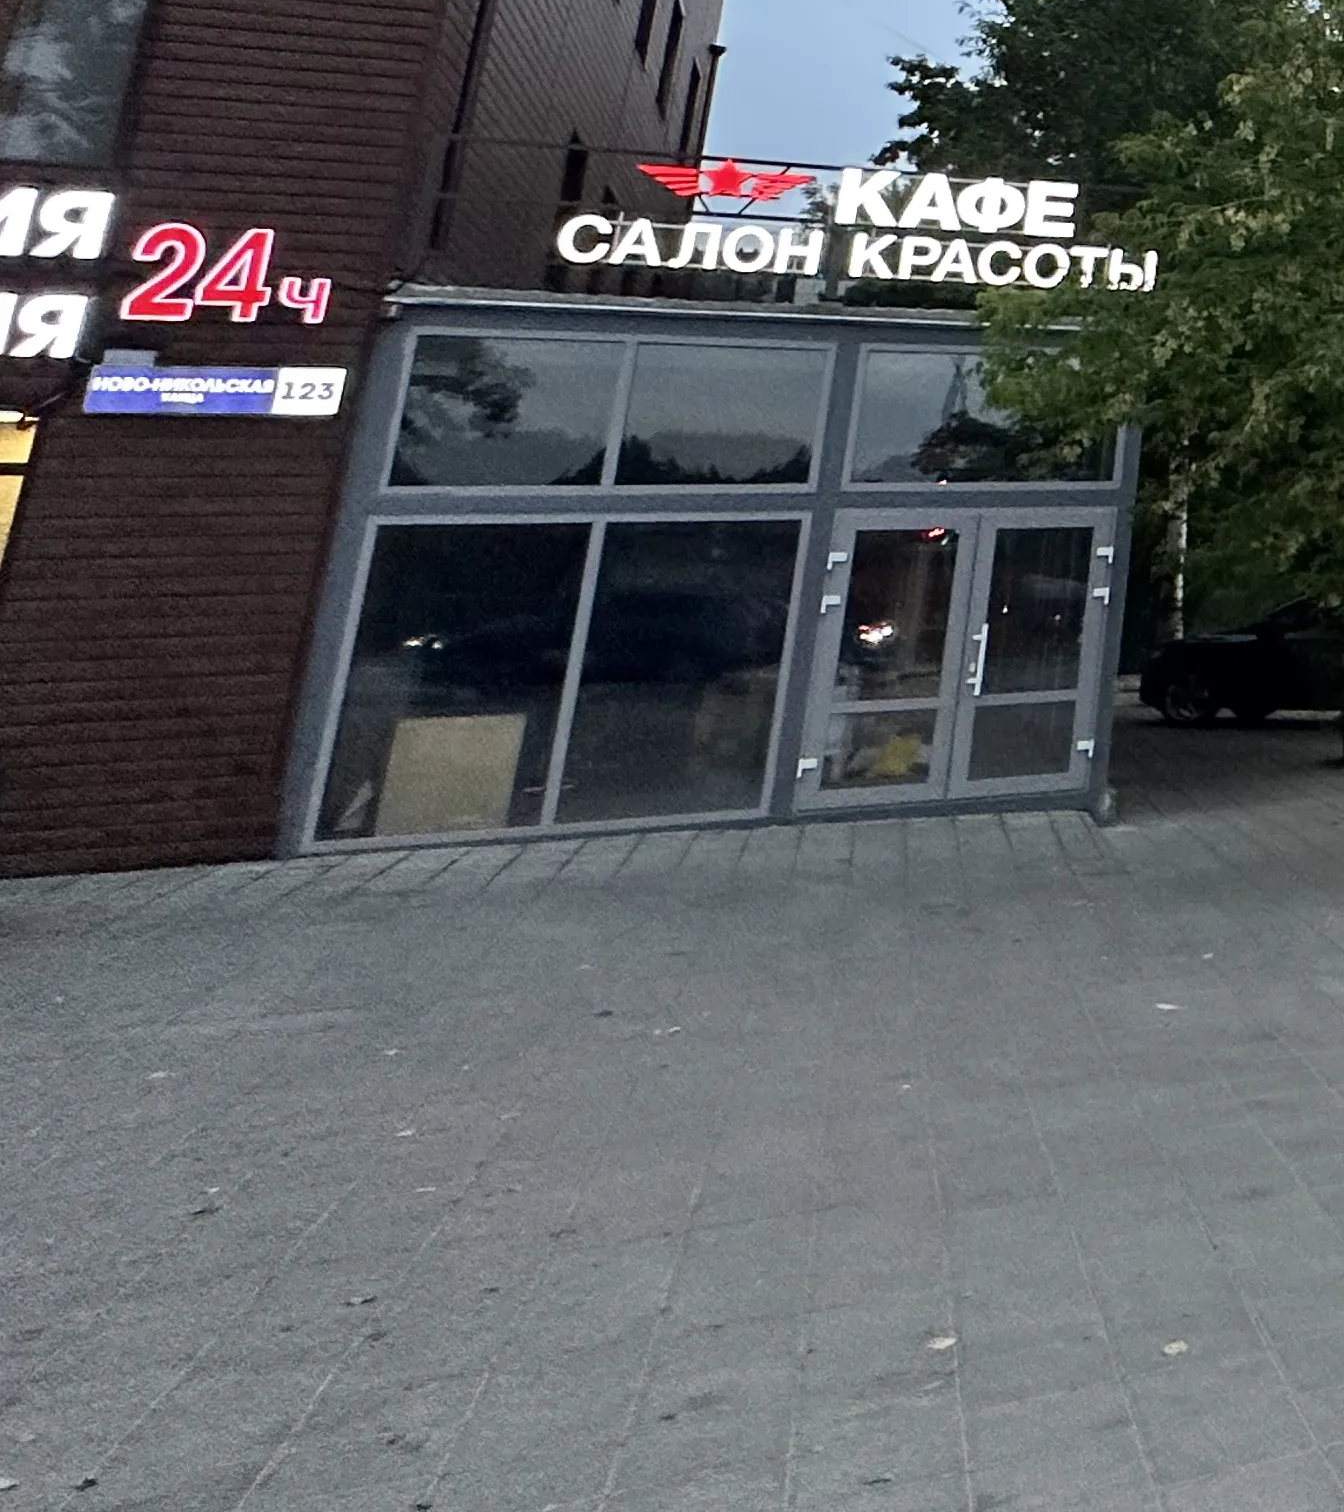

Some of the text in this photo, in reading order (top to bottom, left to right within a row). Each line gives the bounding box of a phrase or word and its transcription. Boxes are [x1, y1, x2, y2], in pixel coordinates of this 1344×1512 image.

[835, 167, 1079, 238] КАФЕ
[556, 214, 1158, 292] САЛОН КРАСОТЫ
[0, 291, 89, 359] Я
[281, 381, 335, 400] 123
